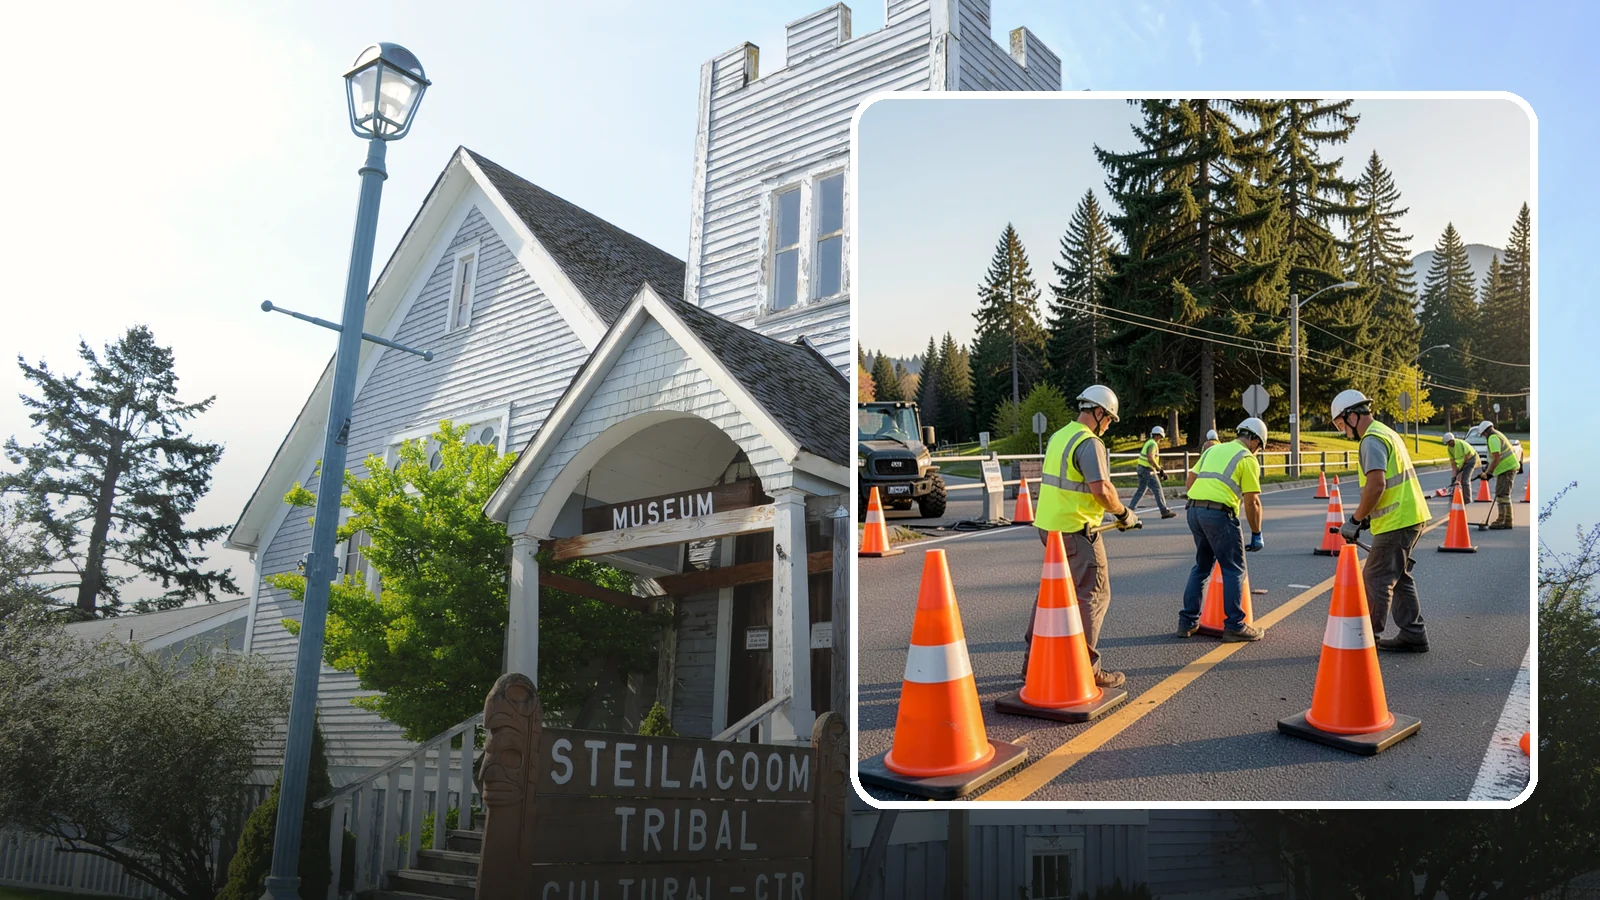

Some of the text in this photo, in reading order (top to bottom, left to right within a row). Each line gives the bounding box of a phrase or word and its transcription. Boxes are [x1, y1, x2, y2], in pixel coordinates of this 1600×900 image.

[613, 492, 714, 531] MUSEUM
[550, 738, 809, 793] STEILACOOM
[615, 806, 758, 852] TRIBAL
